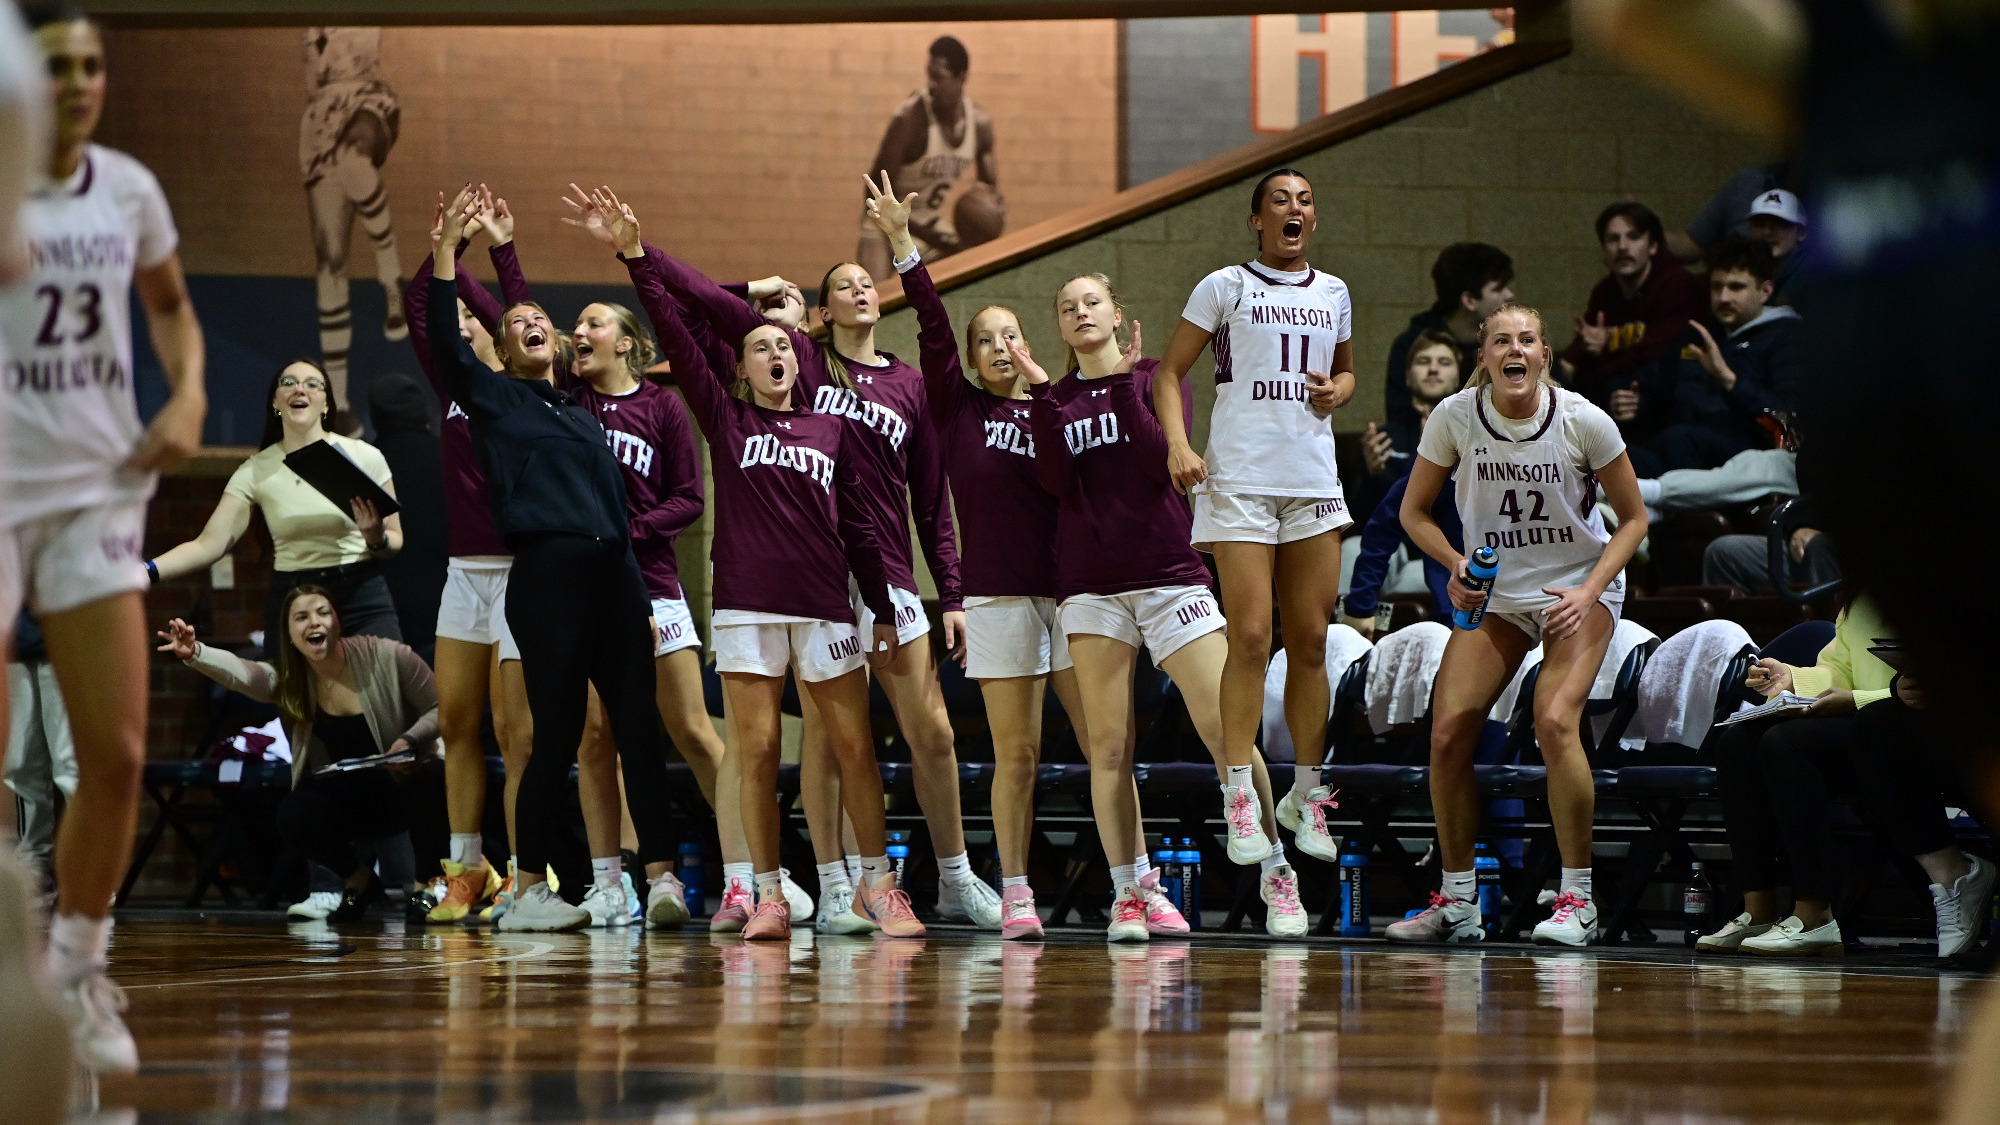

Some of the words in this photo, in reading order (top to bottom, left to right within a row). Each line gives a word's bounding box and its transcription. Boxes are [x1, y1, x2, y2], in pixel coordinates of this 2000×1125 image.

[35, 282, 103, 346] 23
[1251, 305, 1333, 331] MINNESOTA
[1279, 332, 1311, 374] 11
[1251, 380, 1312, 403] DULU
[813, 384, 908, 453] DULUTH
[739, 433, 836, 496] DULUTH
[1477, 463, 1561, 483] MINNESOTA
[1498, 488, 1550, 524] 42
[1485, 526, 1574, 549] DULUTH
[894, 605, 916, 629] MD
[1176, 599, 1211, 626] UMD
[659, 622, 683, 644] MD
[828, 635, 860, 662] UMD
[1183, 864, 1192, 920] POWERADE
[1352, 867, 1361, 924] POWERADE
